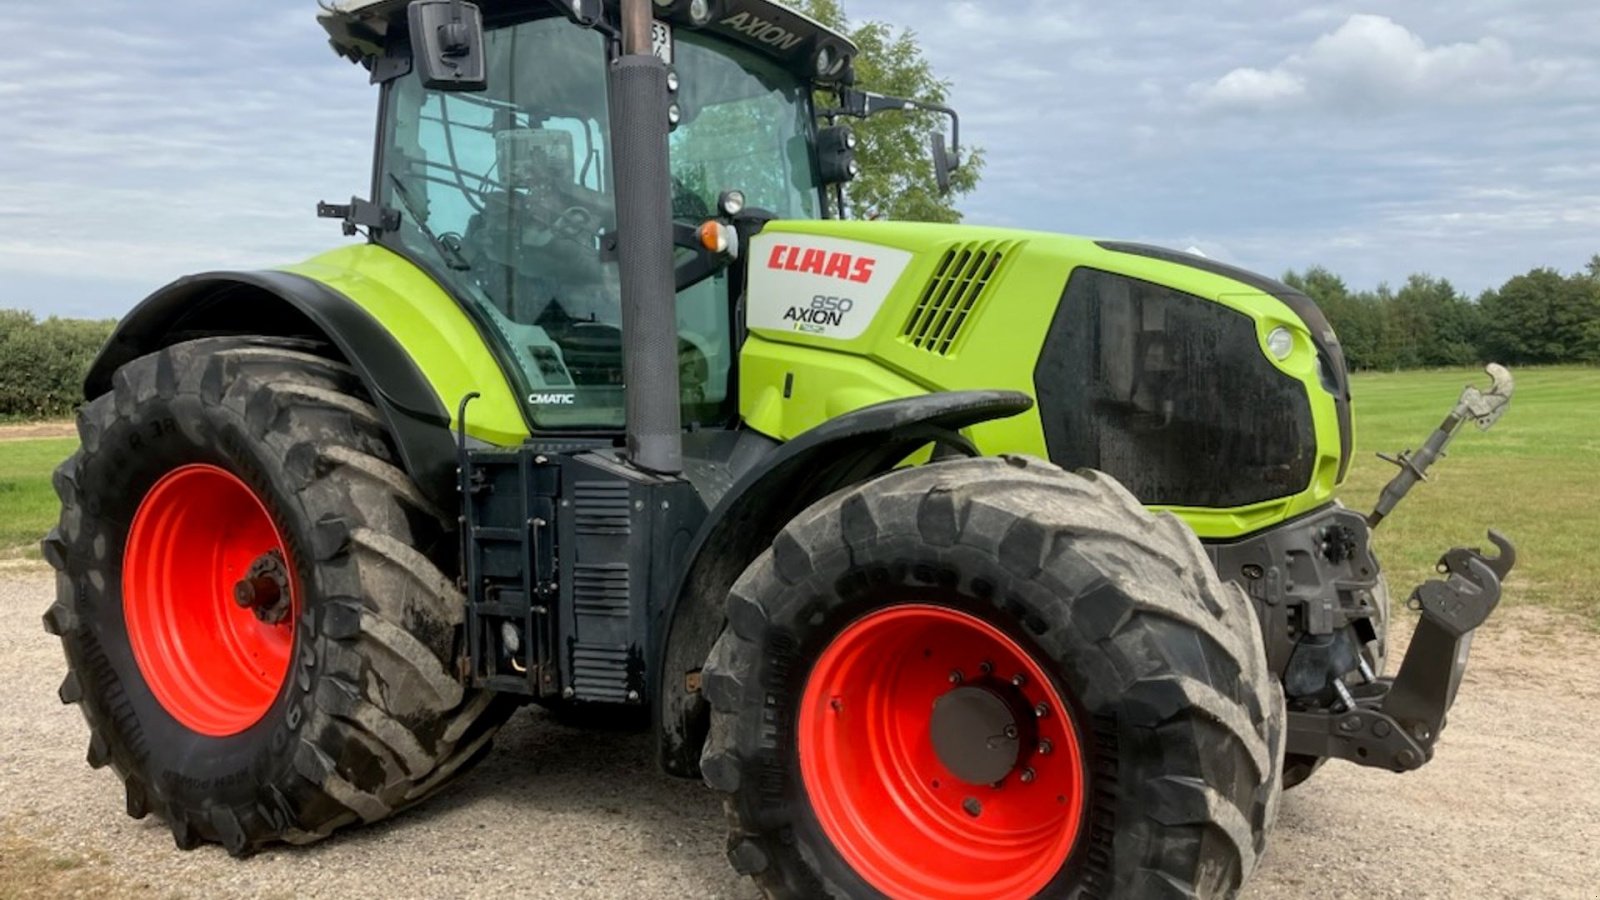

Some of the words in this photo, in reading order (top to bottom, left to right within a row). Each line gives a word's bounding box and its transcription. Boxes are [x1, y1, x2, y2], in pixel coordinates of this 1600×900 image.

[720, 11, 803, 49] AXION
[767, 245, 876, 284] CLAAS
[811, 295, 853, 313] 850
[783, 307, 843, 326] AXION
[528, 393, 575, 405] CMATIC
